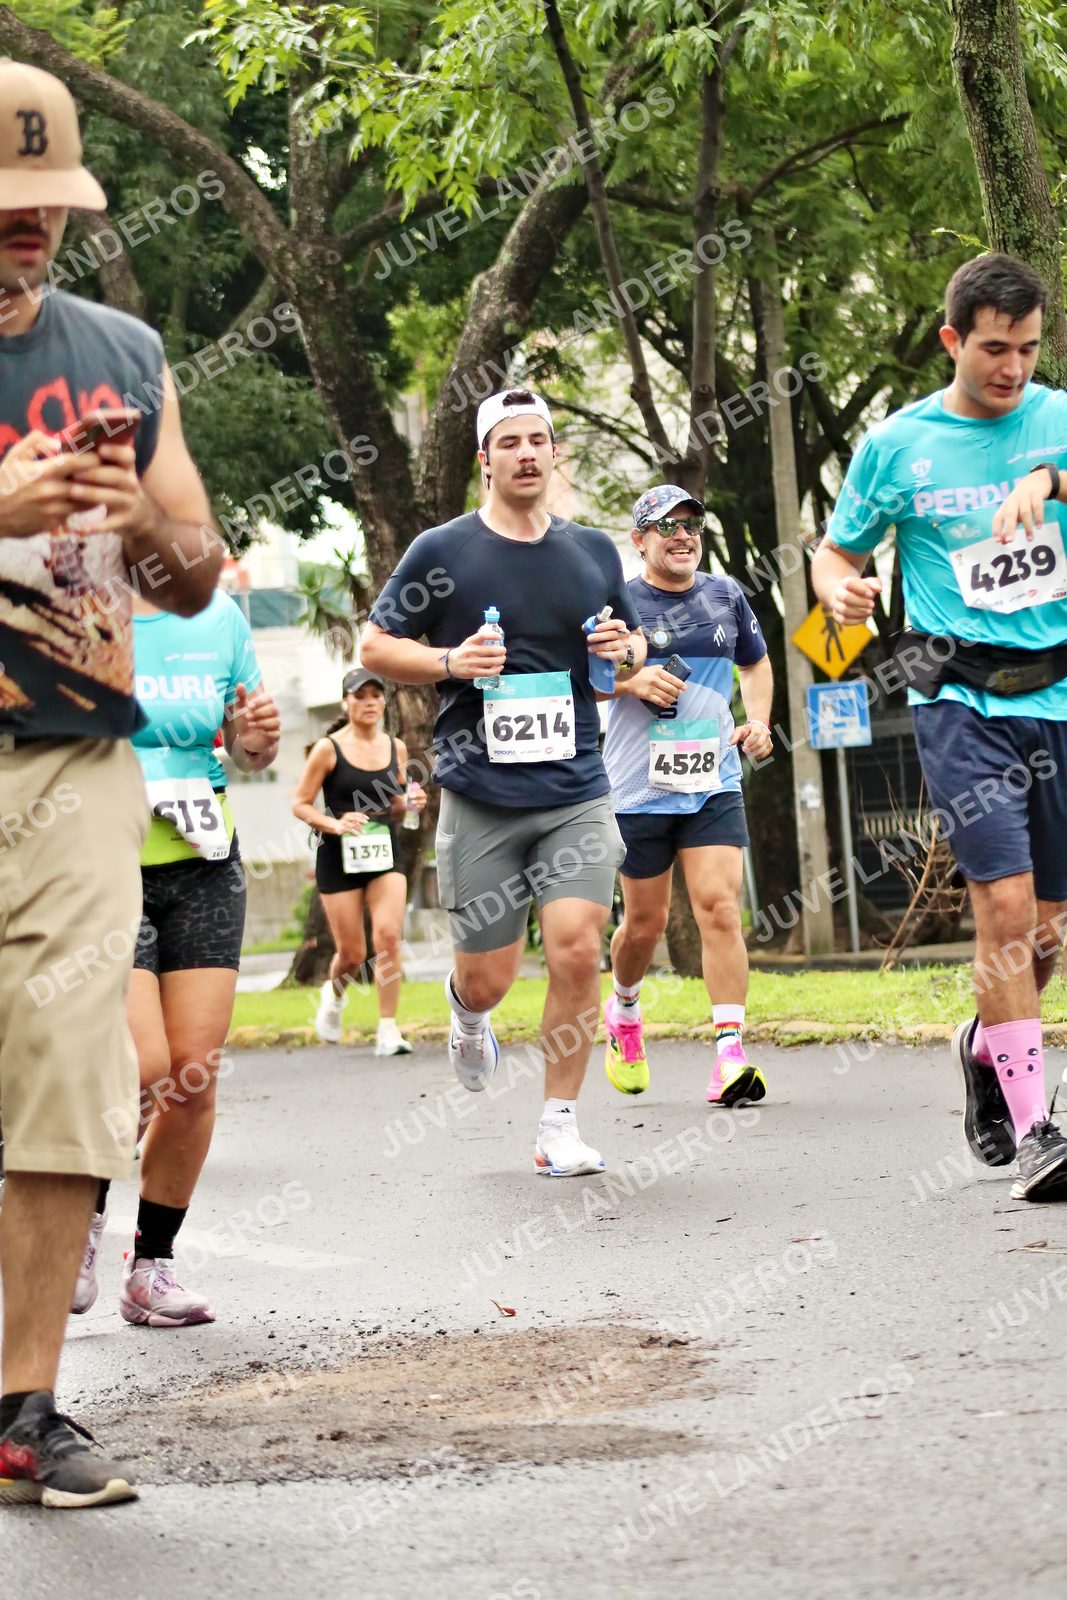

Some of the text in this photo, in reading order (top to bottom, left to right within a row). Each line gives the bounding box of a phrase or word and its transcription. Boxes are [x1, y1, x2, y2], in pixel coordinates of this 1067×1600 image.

[16, 109, 48, 156] B
[970, 545, 1056, 592] 4239
[492, 712, 570, 742] 6214
[654, 751, 715, 775] 4528
[350, 844, 390, 860] 1375
